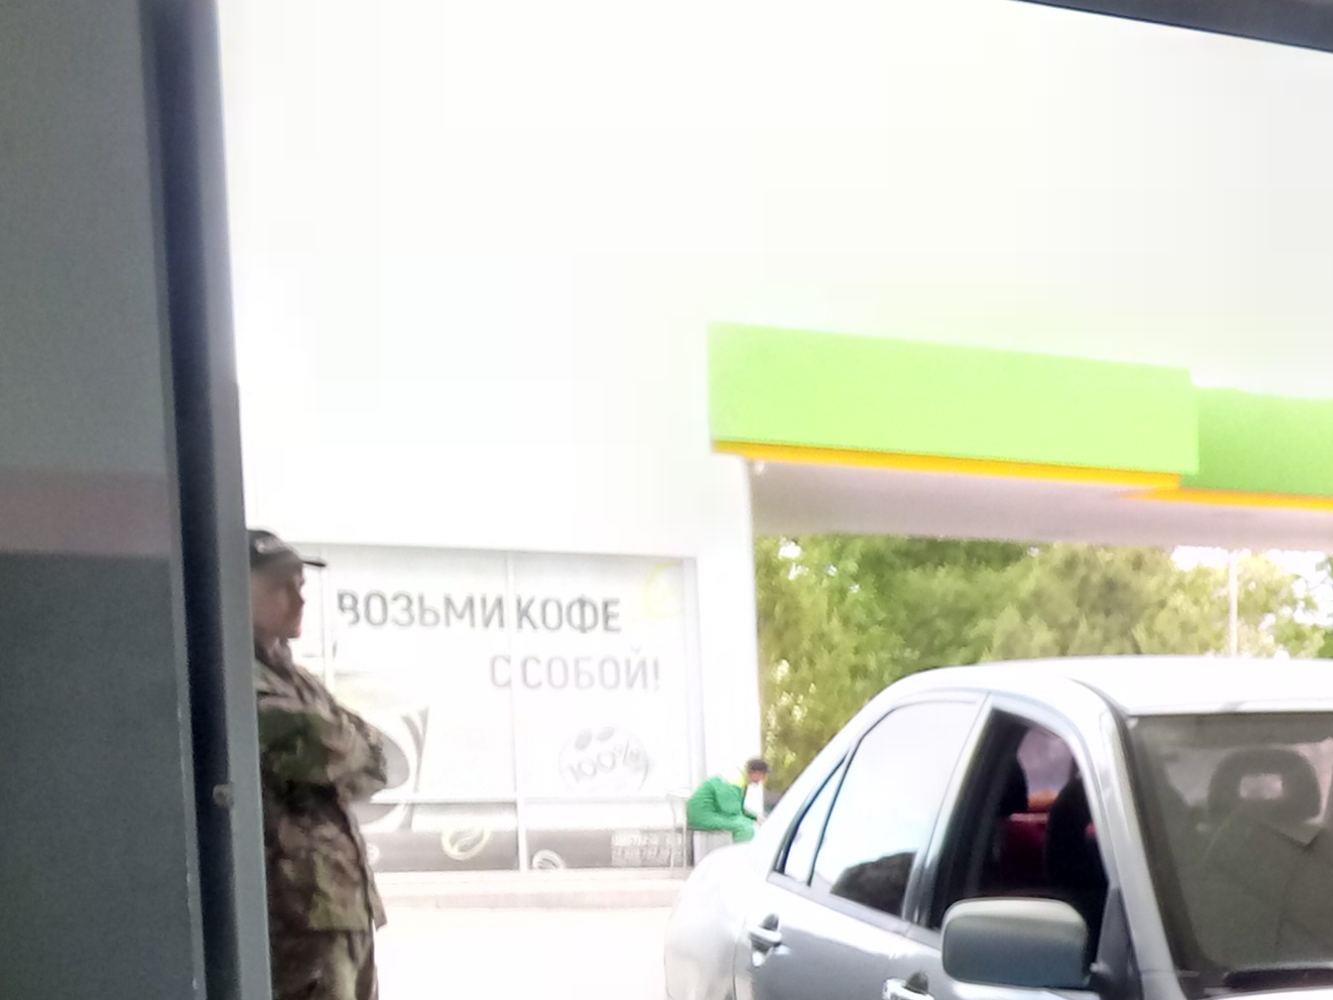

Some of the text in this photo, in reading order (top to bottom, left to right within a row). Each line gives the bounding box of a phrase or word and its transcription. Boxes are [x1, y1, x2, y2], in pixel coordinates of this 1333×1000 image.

[336, 590, 622, 633] ВОЗЬМИ КОФЕ
[490, 646, 660, 691] С СОБОЙ!
